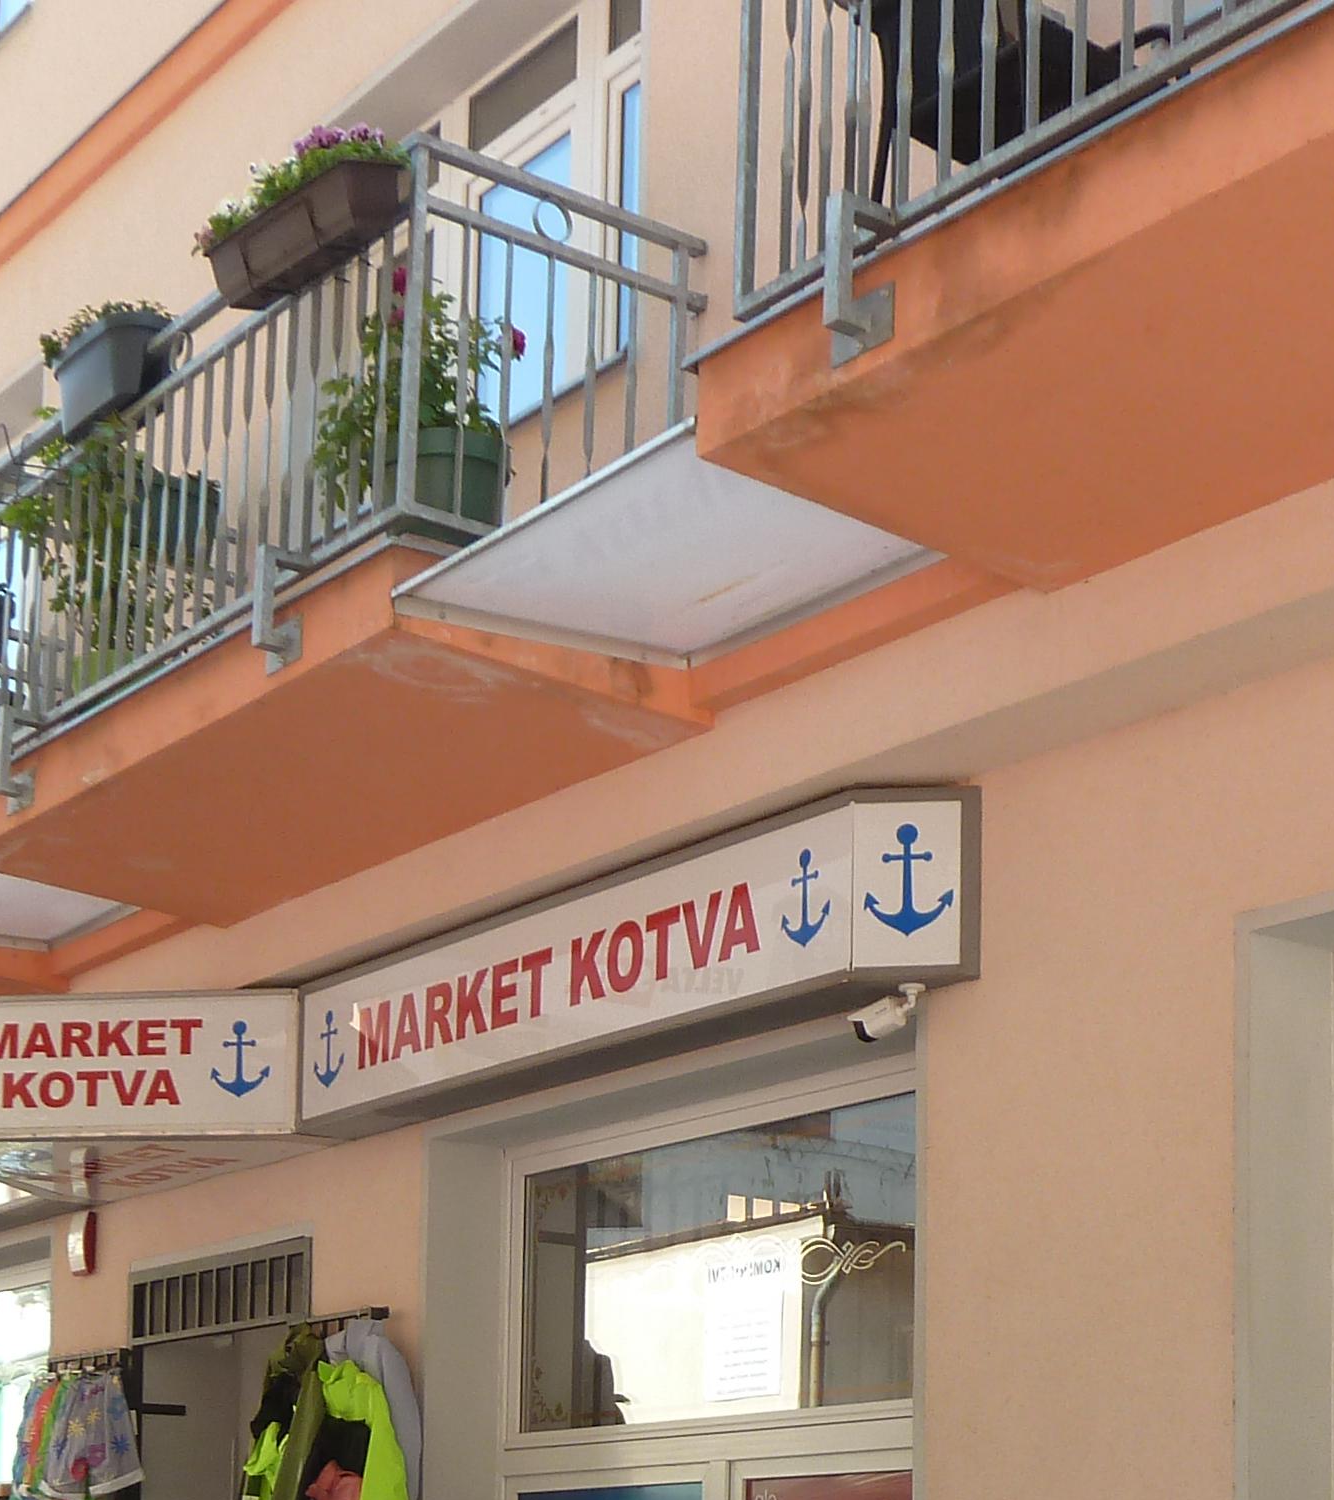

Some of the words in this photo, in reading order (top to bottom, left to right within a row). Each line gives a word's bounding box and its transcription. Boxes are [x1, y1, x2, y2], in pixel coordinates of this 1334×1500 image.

[356, 946, 553, 1070] MARKET
[569, 881, 761, 1008] KOTVA
[1, 1069, 181, 1109] KOTVA
